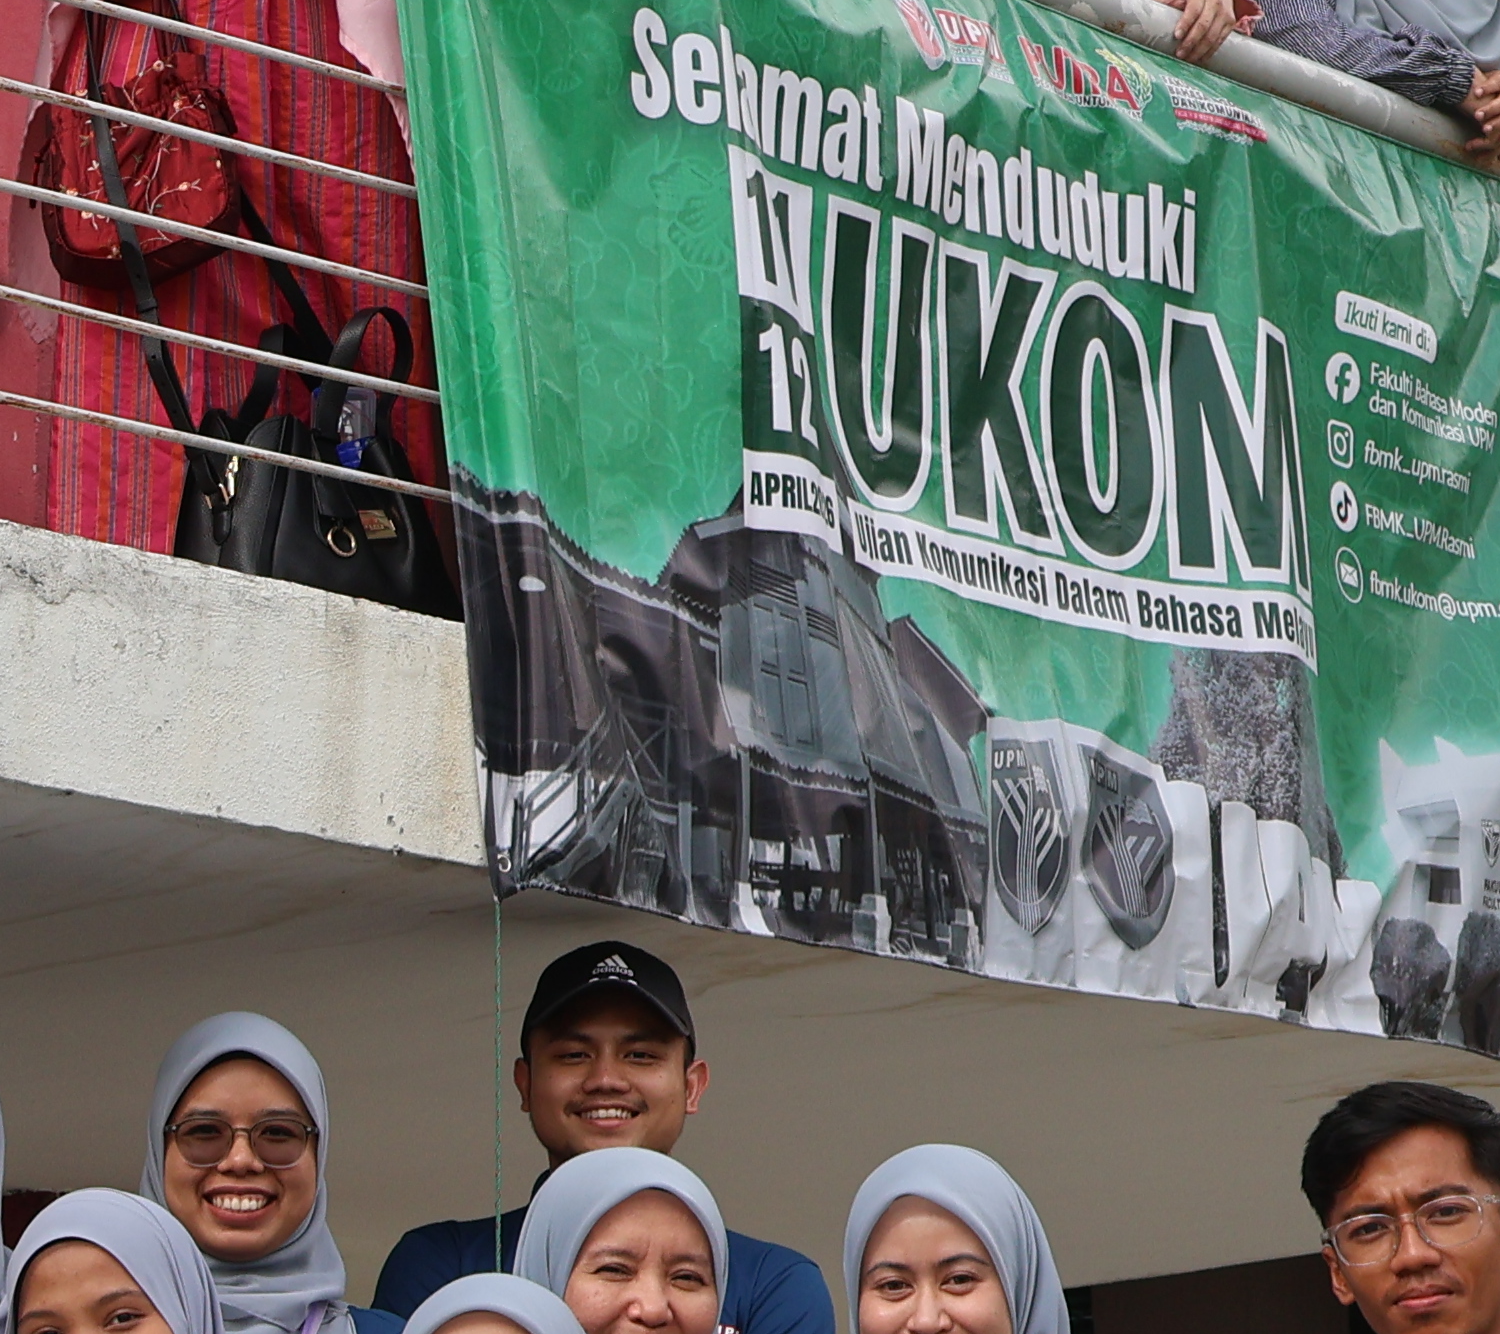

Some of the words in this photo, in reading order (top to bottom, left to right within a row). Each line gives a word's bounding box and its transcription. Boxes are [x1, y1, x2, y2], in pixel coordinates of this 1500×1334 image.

[631, 7, 885, 192] Selamat
[896, 96, 1196, 294] Menduduki
[747, 168, 799, 307] 11
[1344, 301, 1379, 333] Ikuti
[1382, 319, 1413, 346] kami
[1416, 328, 1431, 354] di:
[759, 322, 819, 451] 12
[1370, 361, 1414, 398] Fakulti
[1414, 378, 1449, 416] Bahasa
[1449, 396, 1498, 429] Moden
[1369, 389, 1397, 419] dan
[1401, 398, 1466, 444] Komunikasi
[1466, 425, 1496, 455] UPM
[750, 470, 813, 513] APRIL
[854, 512, 914, 566] Ujian
[915, 531, 1049, 607] Komunikasi
[1055, 571, 1131, 625] Dalam
[1137, 589, 1244, 640] Bahasa
[994, 748, 1027, 770] UPM
[591, 966, 635, 978] adidas
